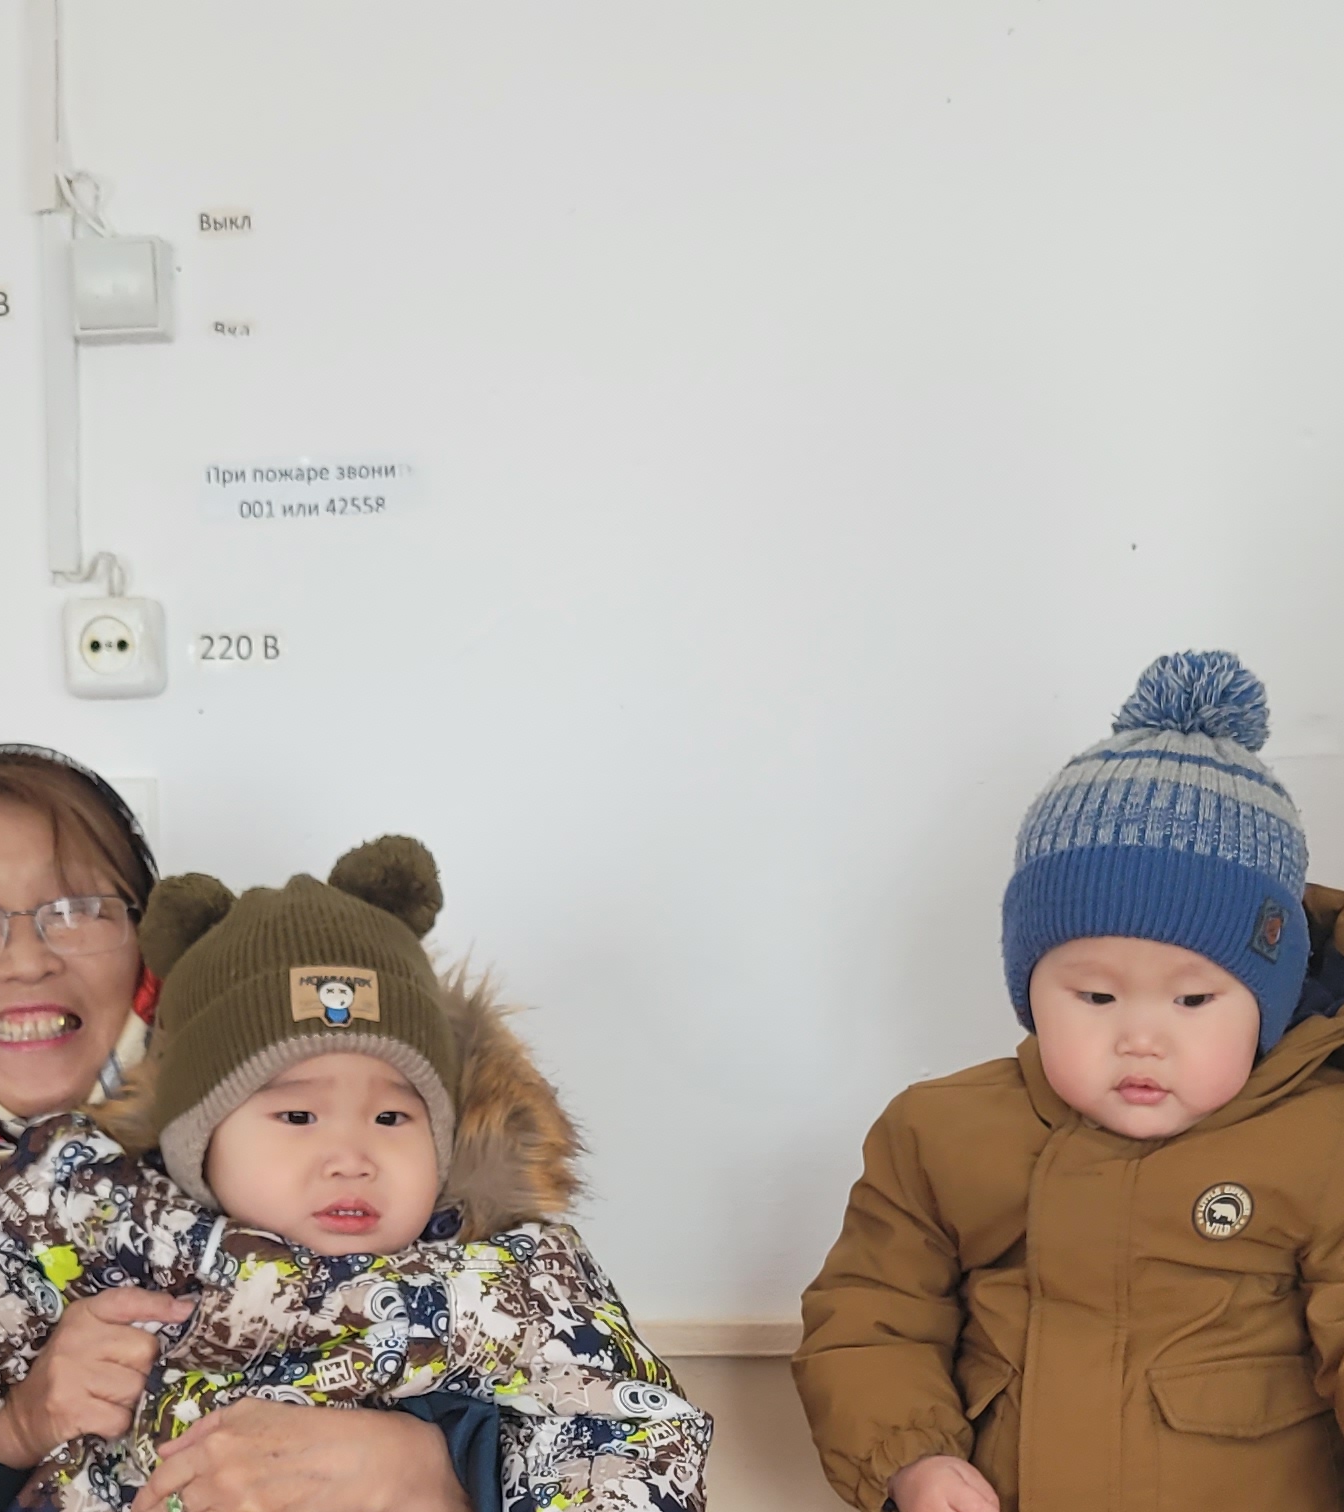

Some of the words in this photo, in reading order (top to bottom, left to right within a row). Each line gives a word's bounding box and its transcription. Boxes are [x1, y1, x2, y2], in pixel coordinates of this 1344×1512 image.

[199, 213, 252, 231] Выкл
[206, 466, 246, 487] При
[253, 465, 330, 486] пожаре
[239, 500, 275, 519] 001
[282, 503, 320, 517] или
[199, 635, 253, 661] 220
[264, 635, 280, 660] В
[1205, 1222, 1231, 1236] WILD
